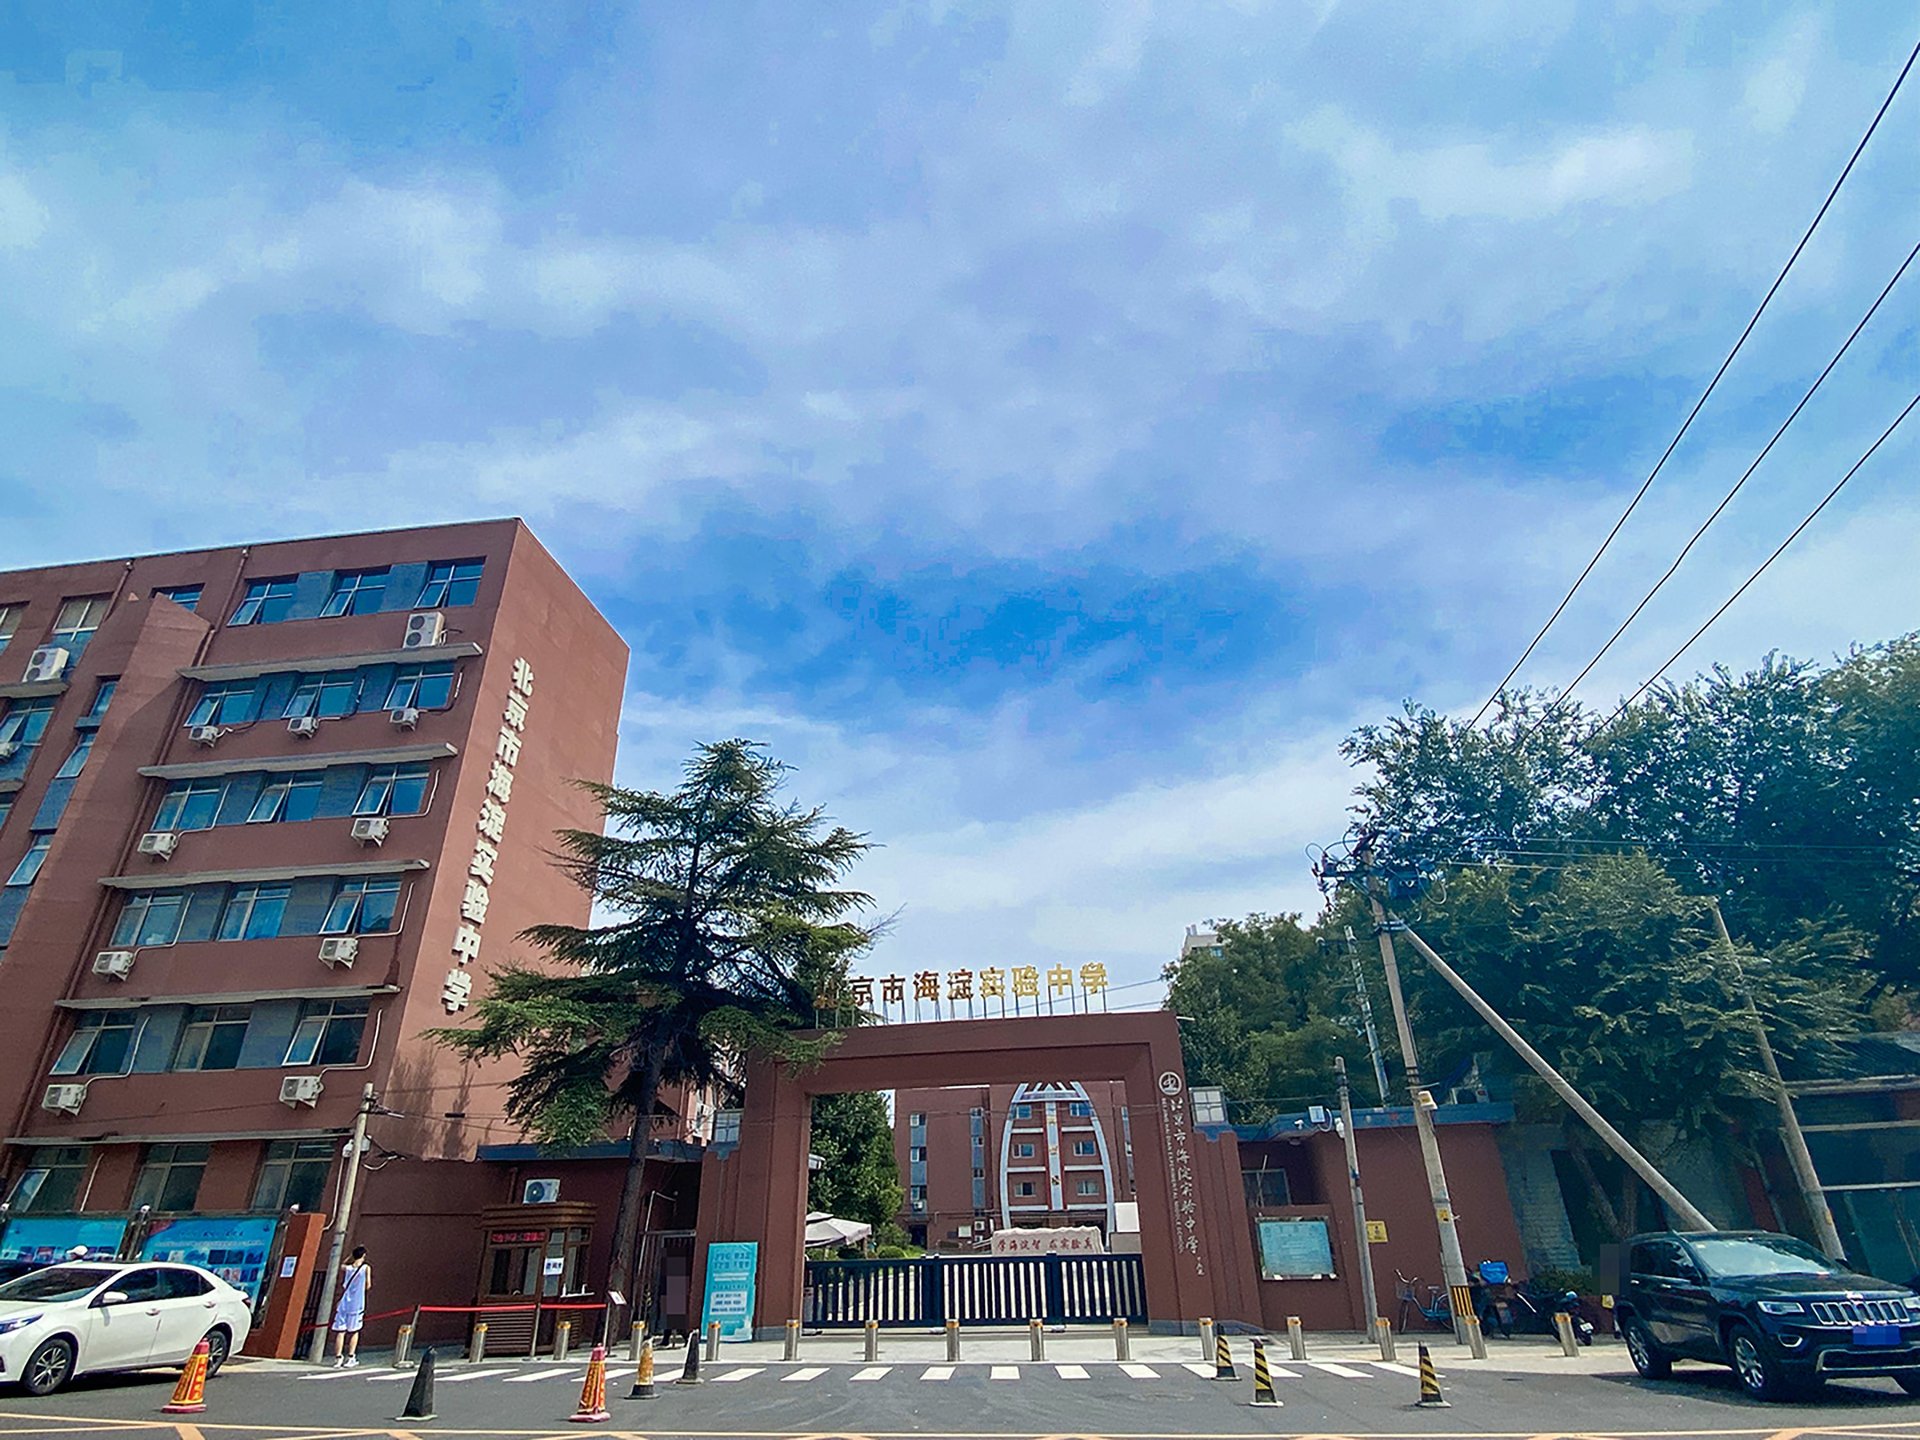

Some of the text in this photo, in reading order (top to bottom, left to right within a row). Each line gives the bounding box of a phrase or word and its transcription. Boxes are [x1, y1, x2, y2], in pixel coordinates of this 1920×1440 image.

[441, 656, 534, 1014] 北京市海淀实验中学
[1167, 1151, 1178, 1200] EXPERIMENTAL
